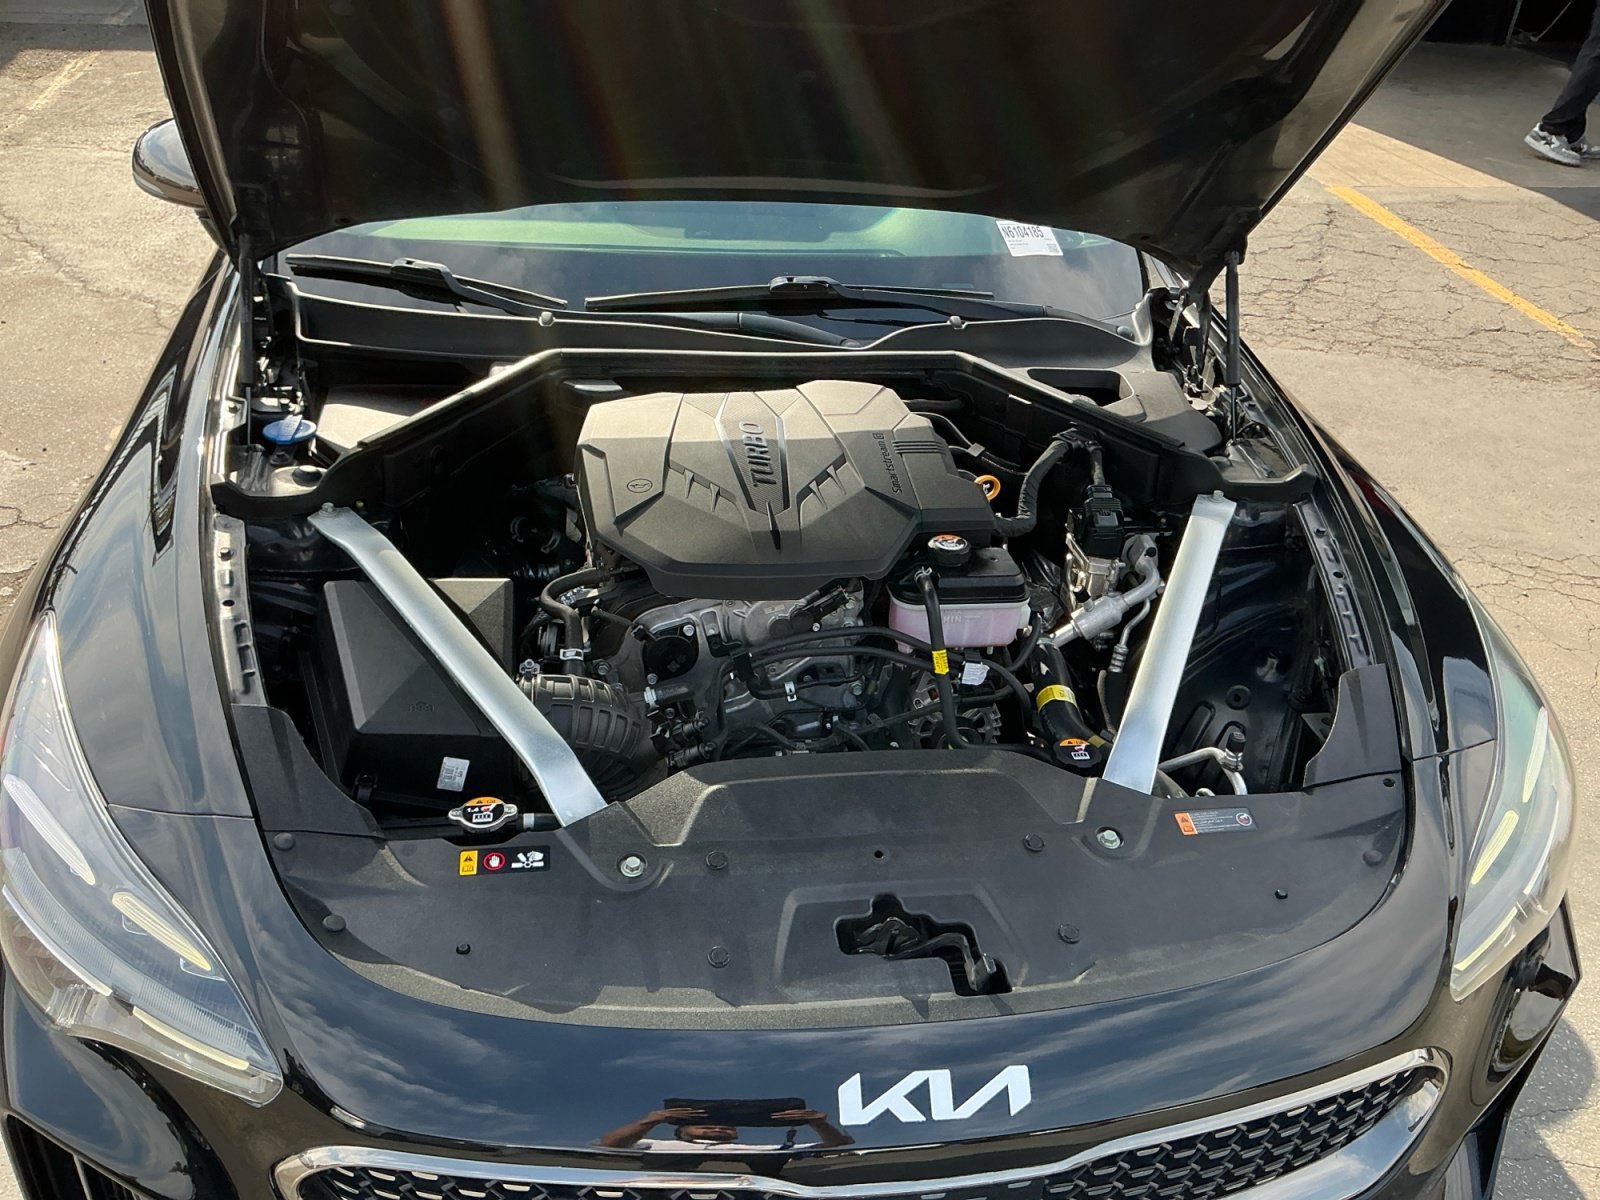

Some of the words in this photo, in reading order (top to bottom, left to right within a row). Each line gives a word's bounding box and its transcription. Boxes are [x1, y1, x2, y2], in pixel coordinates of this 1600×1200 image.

[1001, 225, 1044, 238] N6104185
[739, 420, 777, 488] TURBO
[878, 440, 903, 495] Smartstream
[838, 1065, 1031, 1126] KIA
